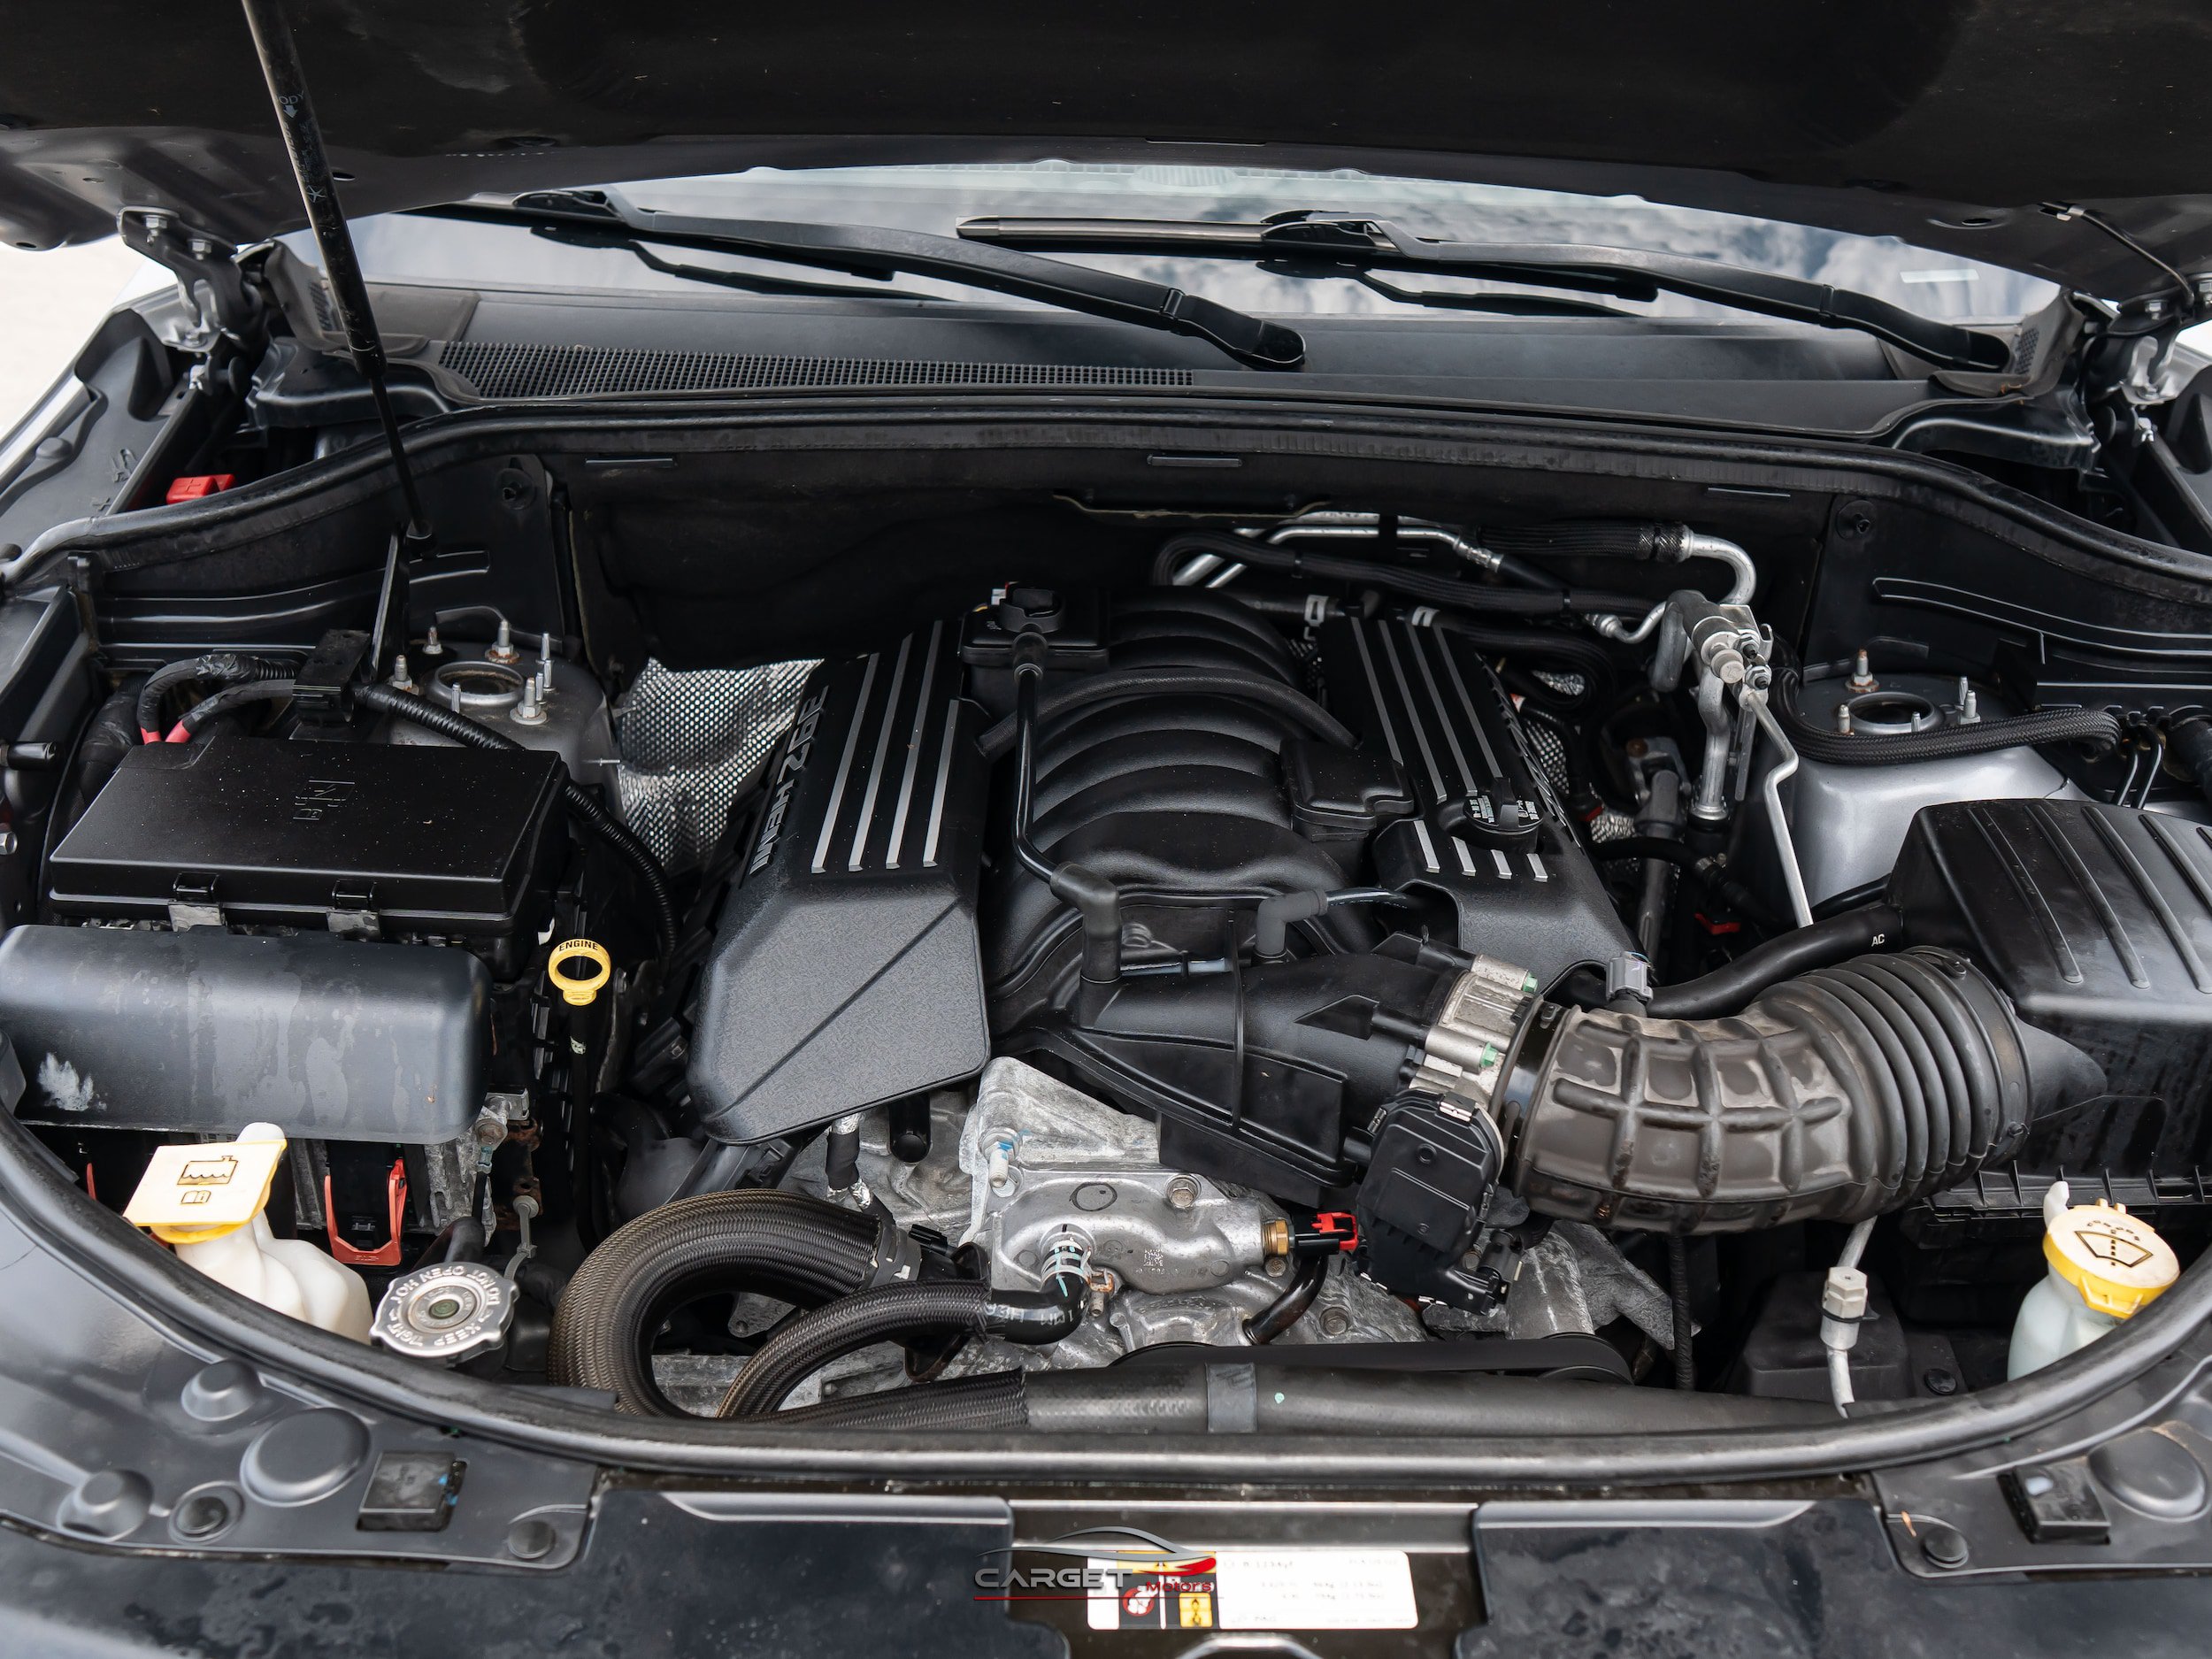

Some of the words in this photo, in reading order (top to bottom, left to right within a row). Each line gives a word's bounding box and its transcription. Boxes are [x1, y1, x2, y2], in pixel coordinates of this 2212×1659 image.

[777, 685, 829, 785] 392
[749, 779, 795, 875] HEMI
[558, 940, 599, 952] ENGINE
[1871, 933, 1886, 947] AC
[419, 1265, 466, 1284] OPEN
[467, 1269, 498, 1290] NOT
[389, 1279, 420, 1304] HOT
[387, 1323, 424, 1348] TIGHT
[434, 1323, 481, 1347] KEEP
